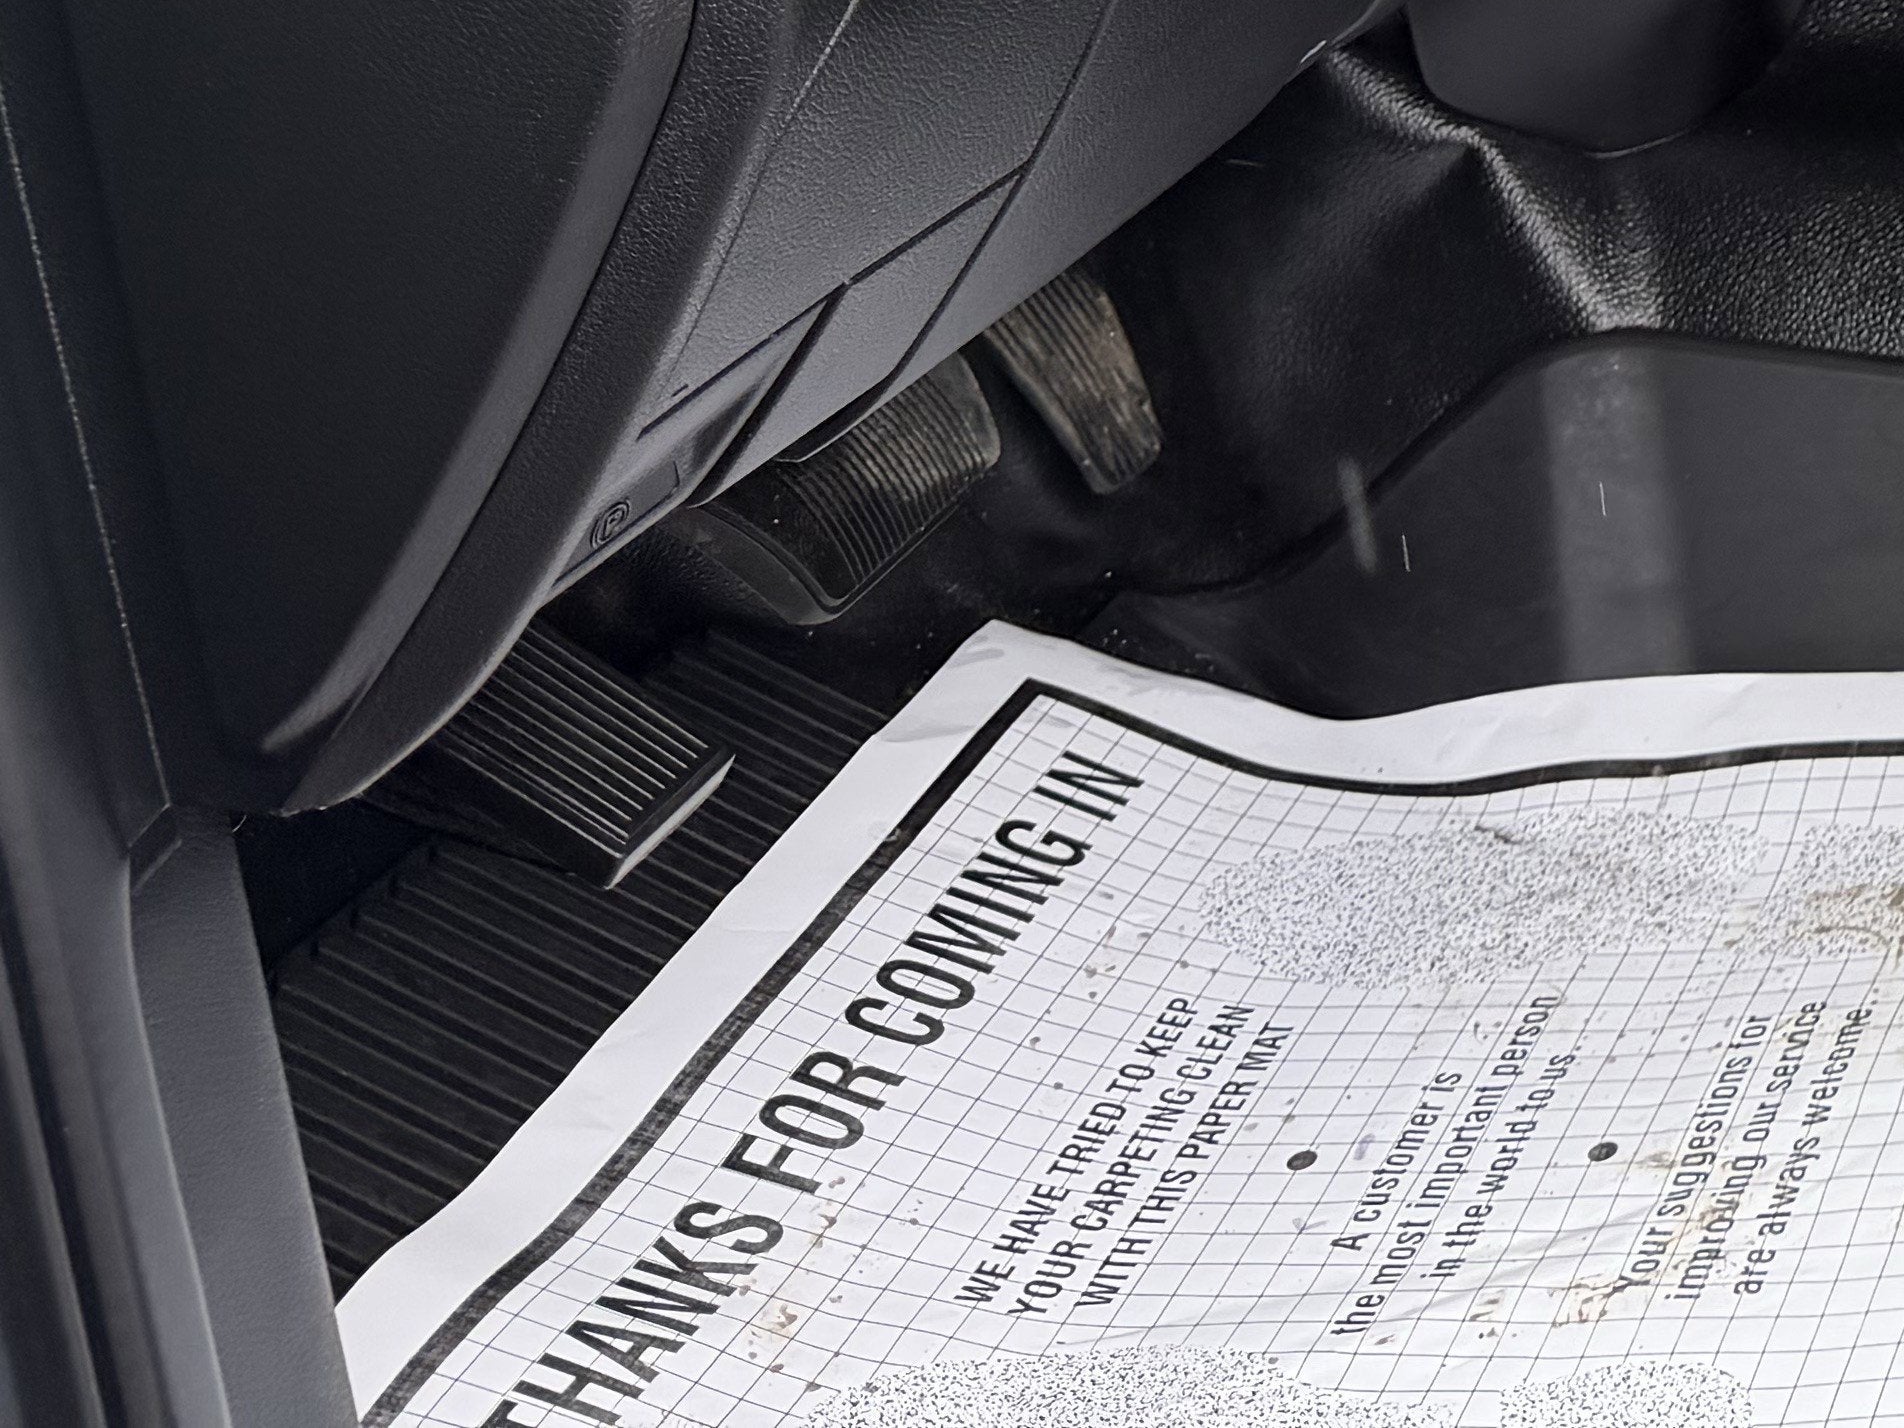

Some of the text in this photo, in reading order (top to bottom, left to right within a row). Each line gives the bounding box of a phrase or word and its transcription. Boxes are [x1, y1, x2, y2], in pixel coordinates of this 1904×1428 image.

[721, 1051, 906, 1194] FOR
[845, 818, 1092, 1046] COMING
[1036, 750, 1145, 822] IN
[1516, 1087, 1556, 1112] to
[953, 997, 1198, 1302] WE HAVE TRIED TO KEEP
[1006, 1004, 1255, 1314] YOUR CARPETING CLEAN
[1074, 1021, 1294, 1307] WITH THIS PAPER MAT
[1330, 1071, 1462, 1251] A customer is
[1330, 995, 1559, 1336] the most important person
[1420, 1257, 1466, 1278] in
[1442, 1203, 1493, 1247] the
[1477, 1120, 1538, 1195] world
[1614, 1014, 1773, 1293] Your suggestions for
[1664, 1000, 1828, 1300] improving our service
[1733, 1248, 1777, 1296] are
[1757, 1136, 1821, 1237] always
